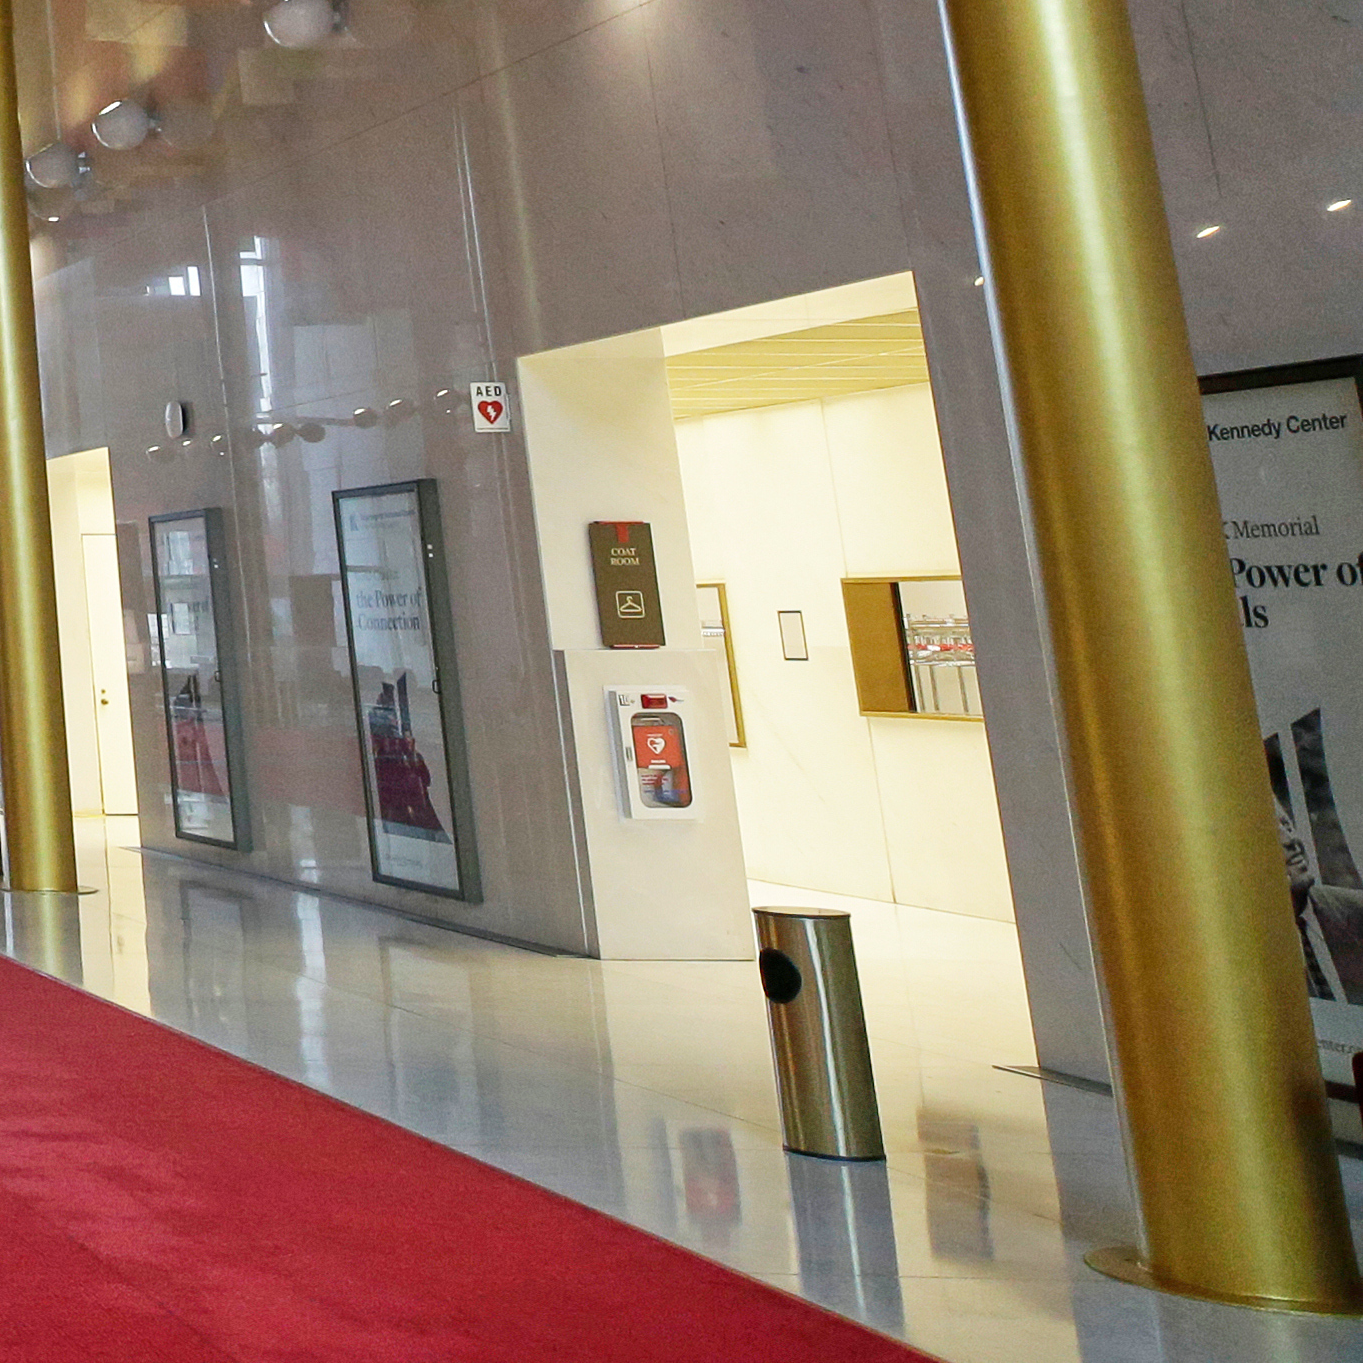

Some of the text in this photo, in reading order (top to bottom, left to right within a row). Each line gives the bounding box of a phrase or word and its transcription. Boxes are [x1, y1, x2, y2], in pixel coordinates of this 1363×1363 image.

[476, 386, 502, 396] AED
[1207, 413, 1347, 442] Kennedy Center
[1232, 515, 1320, 539] Memorial
[610, 557, 640, 565] ROOM
[611, 547, 636, 556] COAT
[1230, 557, 1328, 588] Power
[356, 587, 422, 609] the Power of
[358, 611, 420, 631] Connection
